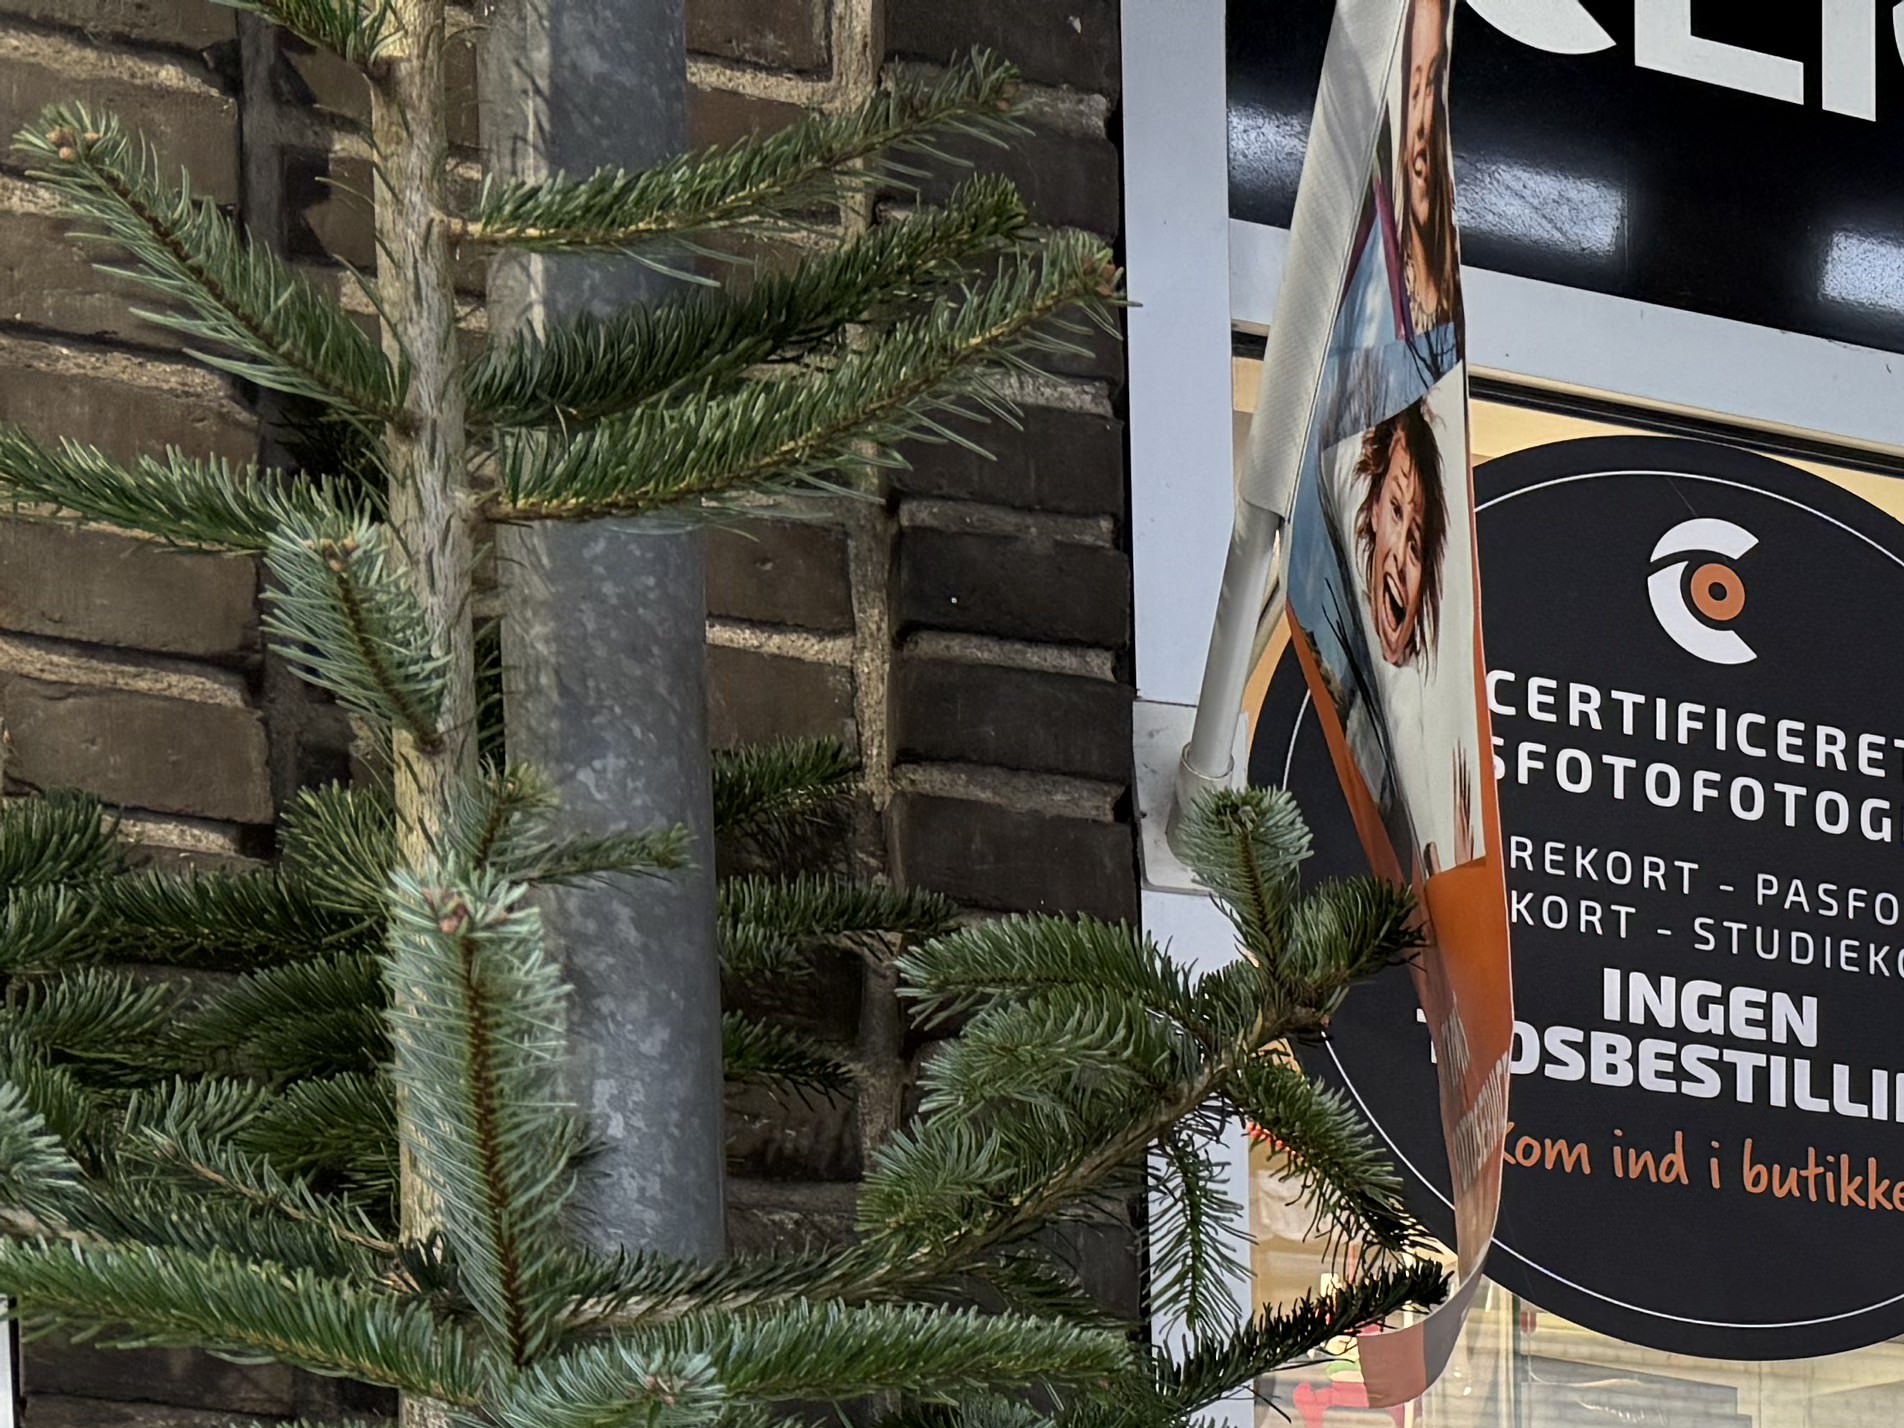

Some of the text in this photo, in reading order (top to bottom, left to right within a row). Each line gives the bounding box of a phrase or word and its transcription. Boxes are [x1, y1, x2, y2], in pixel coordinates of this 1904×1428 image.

[1509, 836, 1699, 896] REKORT
[1509, 891, 1637, 942] KORT
[1603, 967, 1820, 1048] INGEN
[1613, 1128, 1688, 1187] ind
